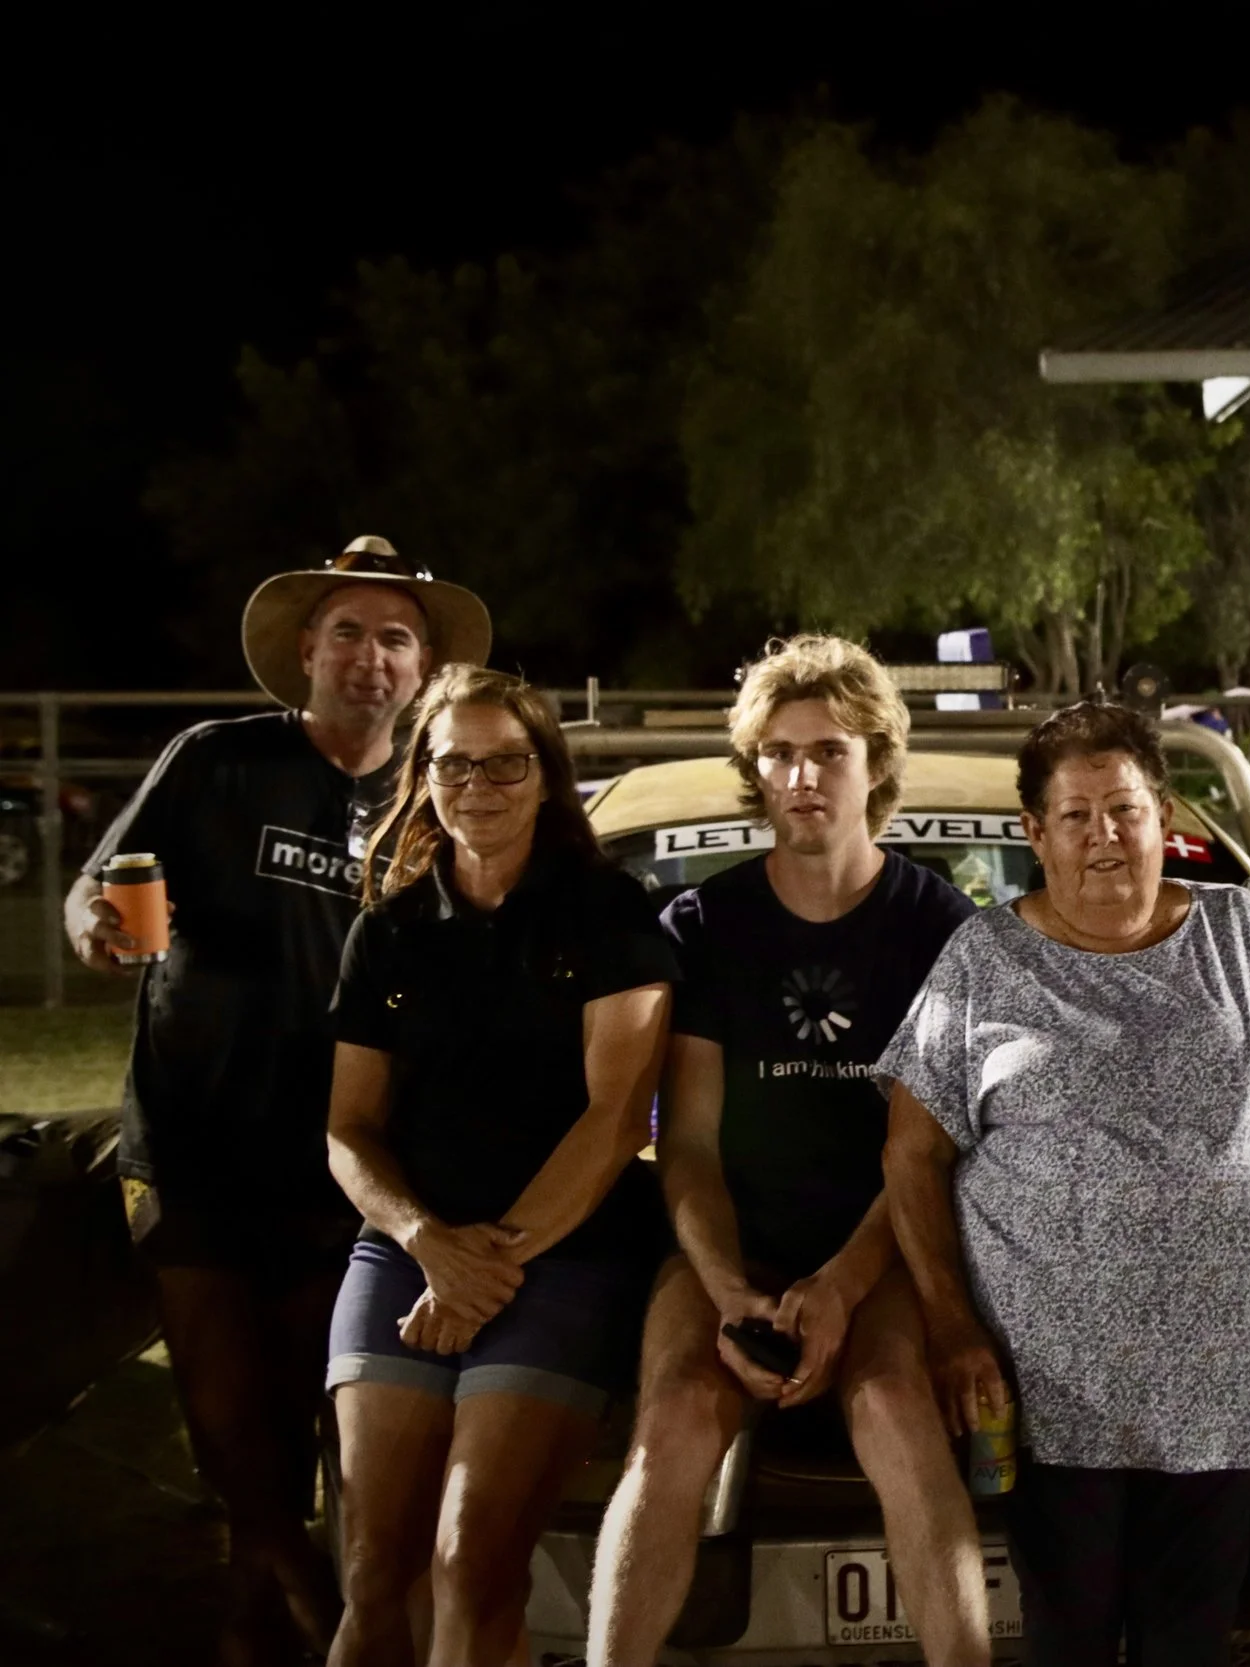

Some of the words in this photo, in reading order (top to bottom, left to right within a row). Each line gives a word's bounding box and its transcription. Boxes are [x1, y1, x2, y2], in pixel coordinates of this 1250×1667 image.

[271, 840, 364, 885] more
[758, 1060, 765, 1079] I
[771, 1060, 808, 1077] am
[841, 1625, 918, 1641] QUEENSL
